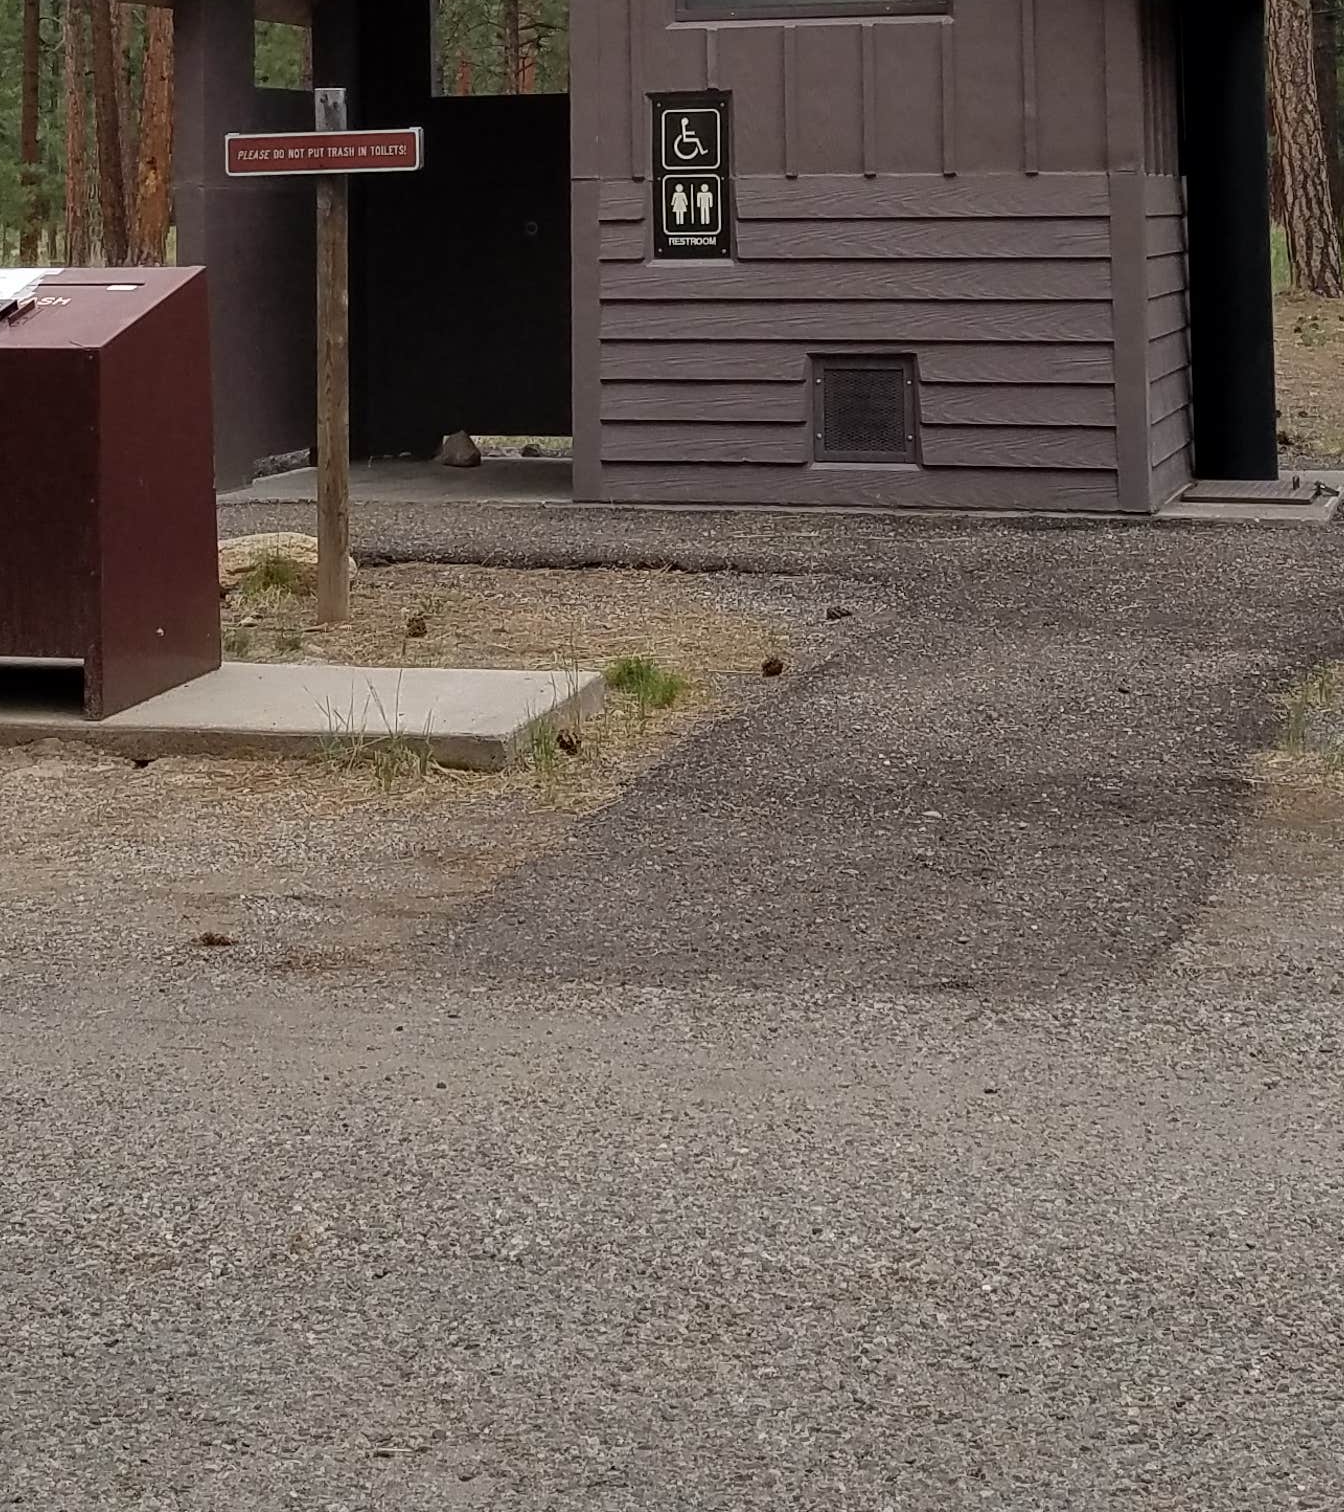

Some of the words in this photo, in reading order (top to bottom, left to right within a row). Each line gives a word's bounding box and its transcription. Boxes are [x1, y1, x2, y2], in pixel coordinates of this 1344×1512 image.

[237, 149, 271, 161] PLEASE
[273, 148, 285, 160] DO
[288, 148, 305, 159] NOT
[307, 147, 325, 159] PUT
[328, 146, 355, 158] TRASH
[357, 145, 367, 157] IN
[370, 144, 407, 157] TOILETS!
[668, 236, 717, 247] RESTROOM
